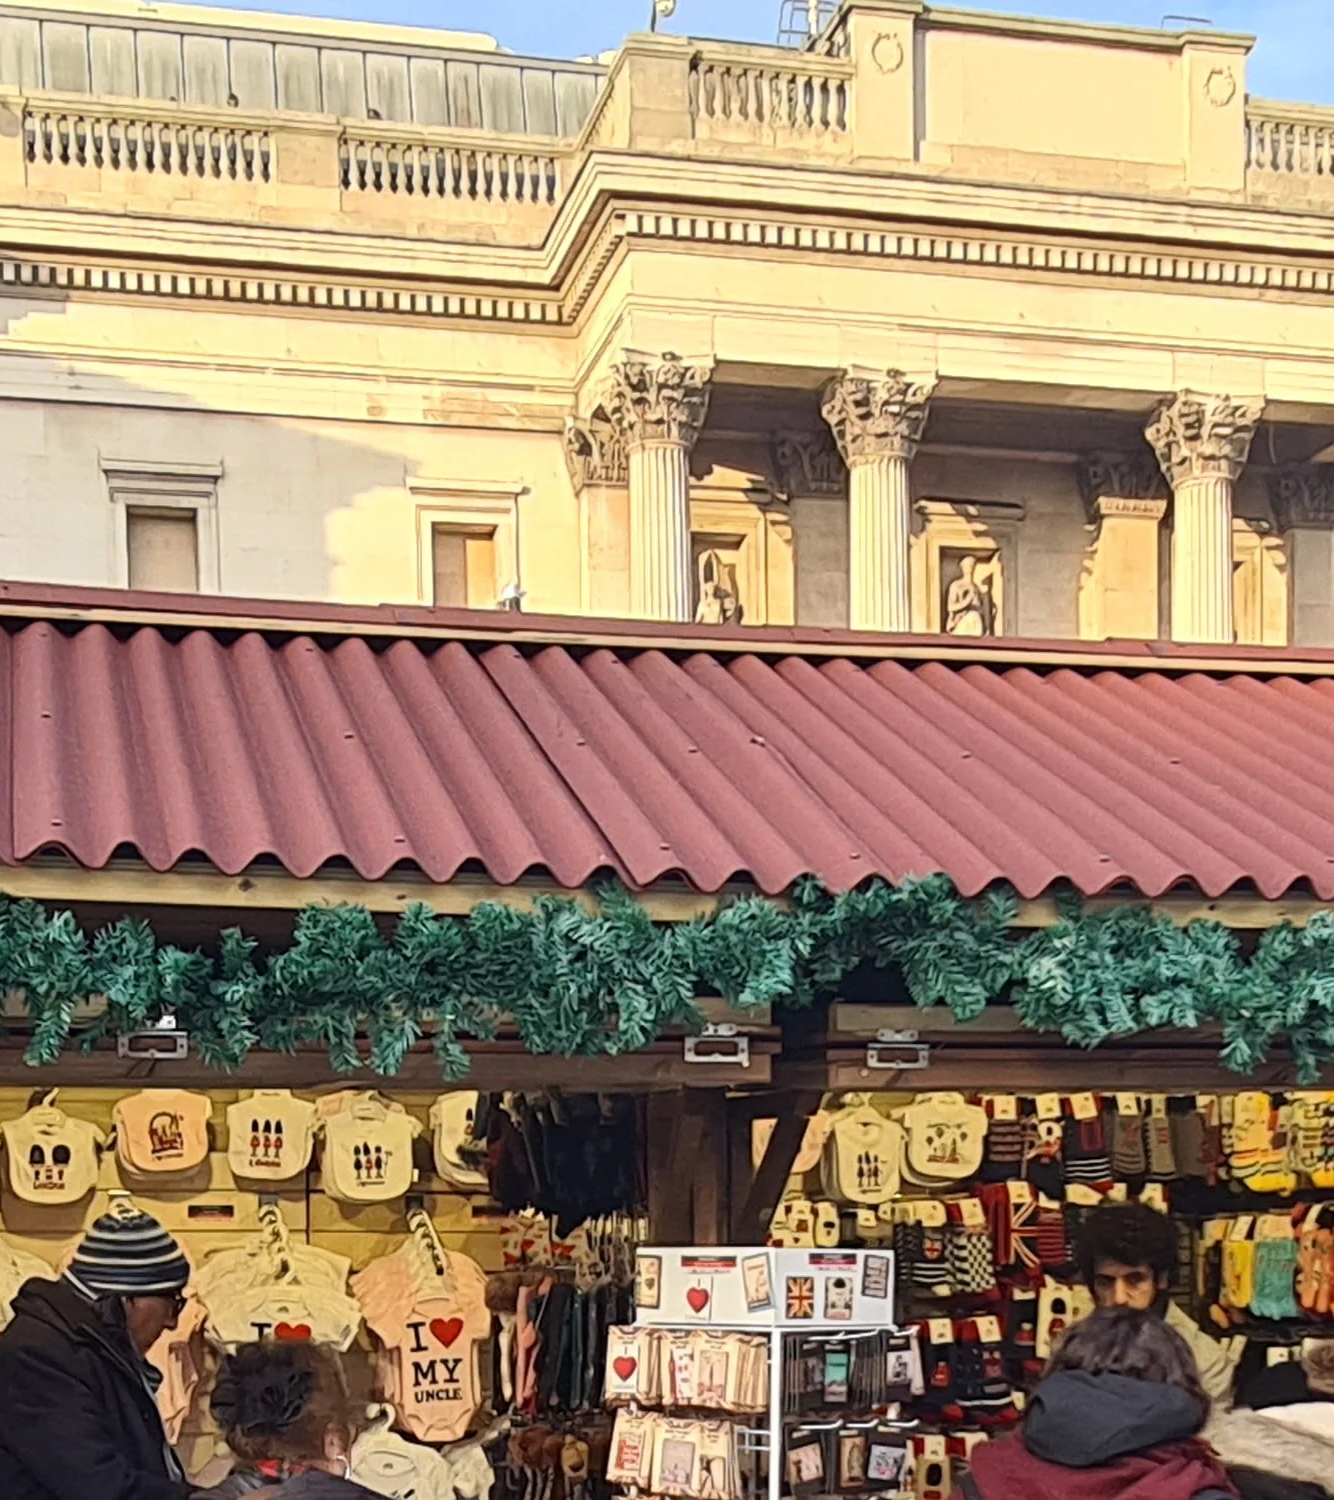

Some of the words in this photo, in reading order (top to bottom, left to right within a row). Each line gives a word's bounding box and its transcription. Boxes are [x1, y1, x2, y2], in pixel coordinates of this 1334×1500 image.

[406, 1321, 429, 1353] I
[411, 1358, 463, 1387] MY
[414, 1388, 463, 1404] UNCLE
